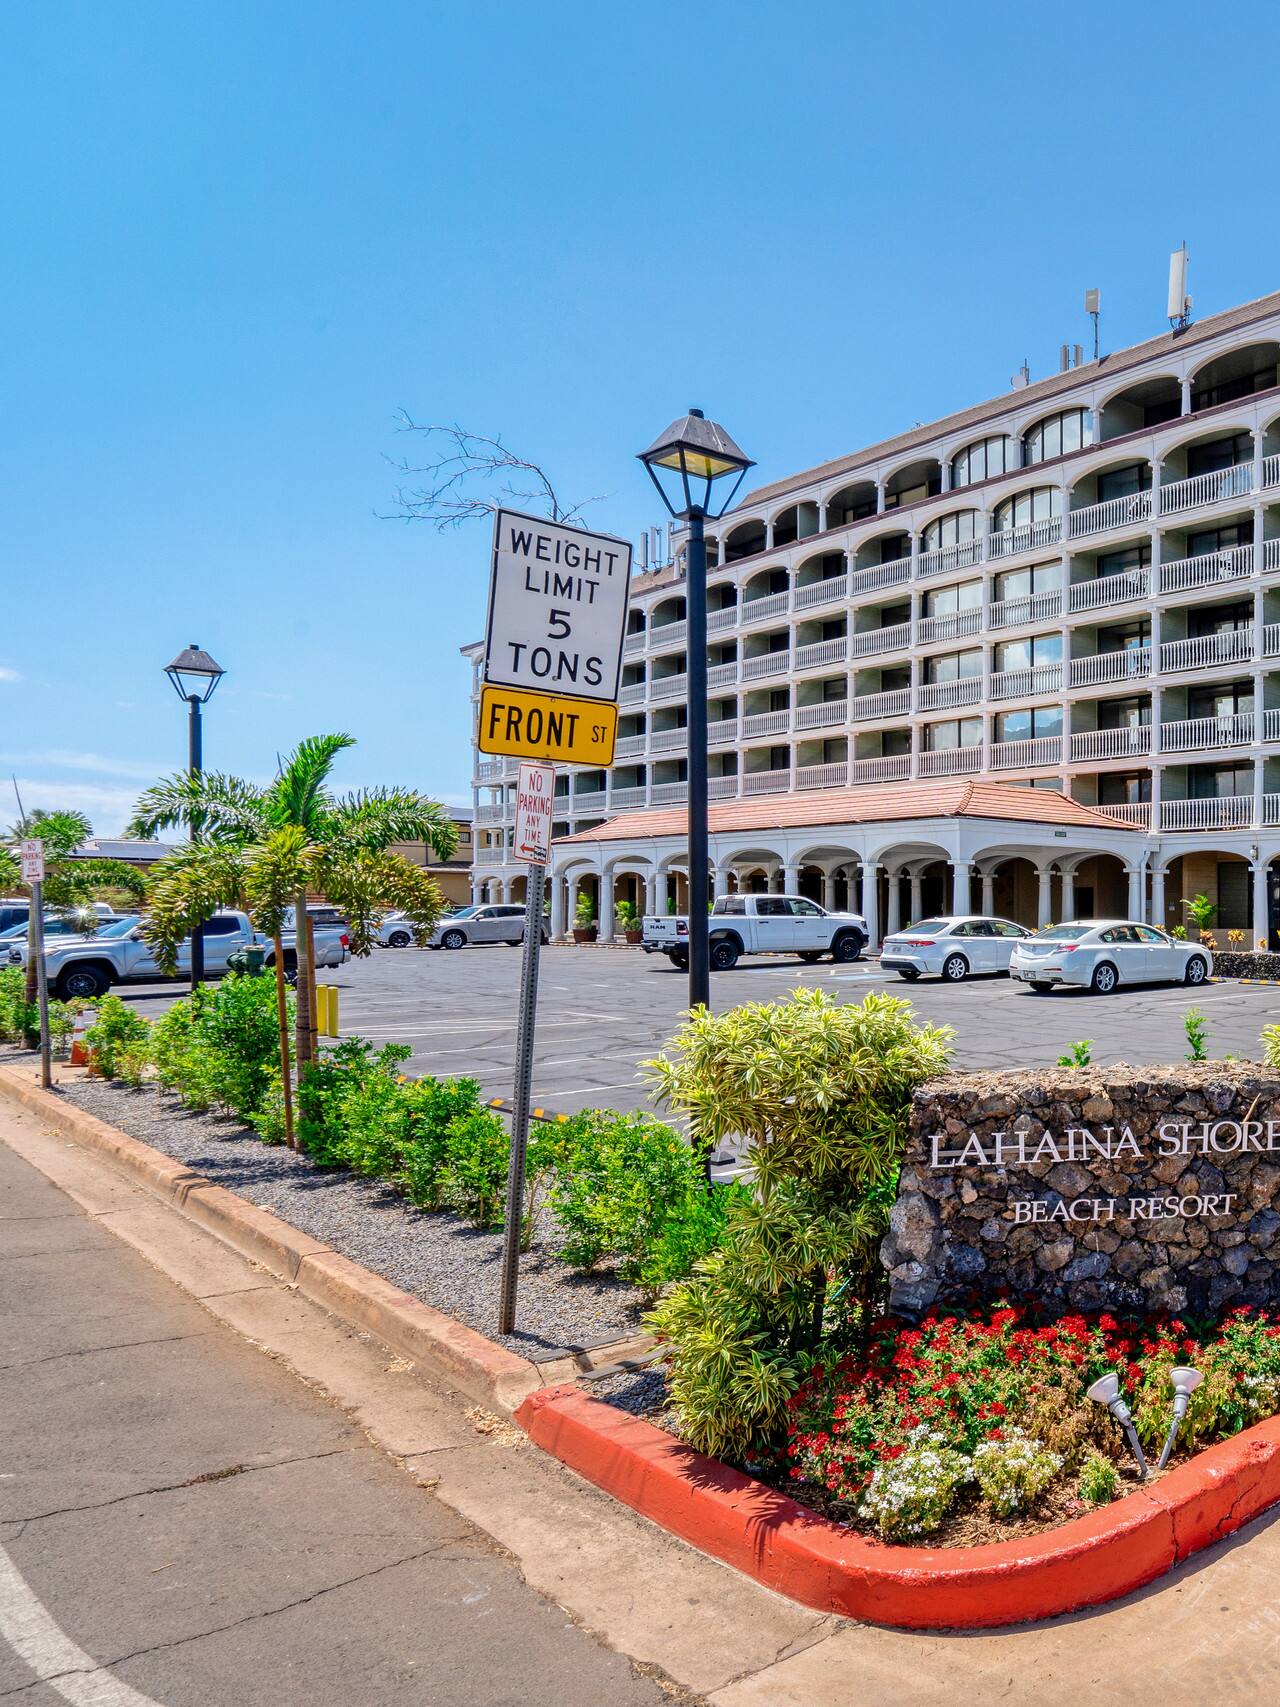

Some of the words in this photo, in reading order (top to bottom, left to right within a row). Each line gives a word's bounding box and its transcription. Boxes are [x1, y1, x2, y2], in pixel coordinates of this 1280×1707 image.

[511, 528, 619, 577] WEIGHT
[525, 566, 600, 604] LIMIT
[547, 608, 571, 640] 5
[508, 641, 603, 686] TONS
[488, 703, 580, 749] FRONT
[591, 724, 608, 744] ST
[528, 773, 543, 792] NO
[519, 793, 551, 816] PARKING
[524, 828, 542, 843] TIME
[526, 814, 541, 828] ANY
[928, 1126, 1143, 1169] LAHAINA
[1013, 1198, 1116, 1225] BEACH
[1128, 1194, 1238, 1221] RESORT
